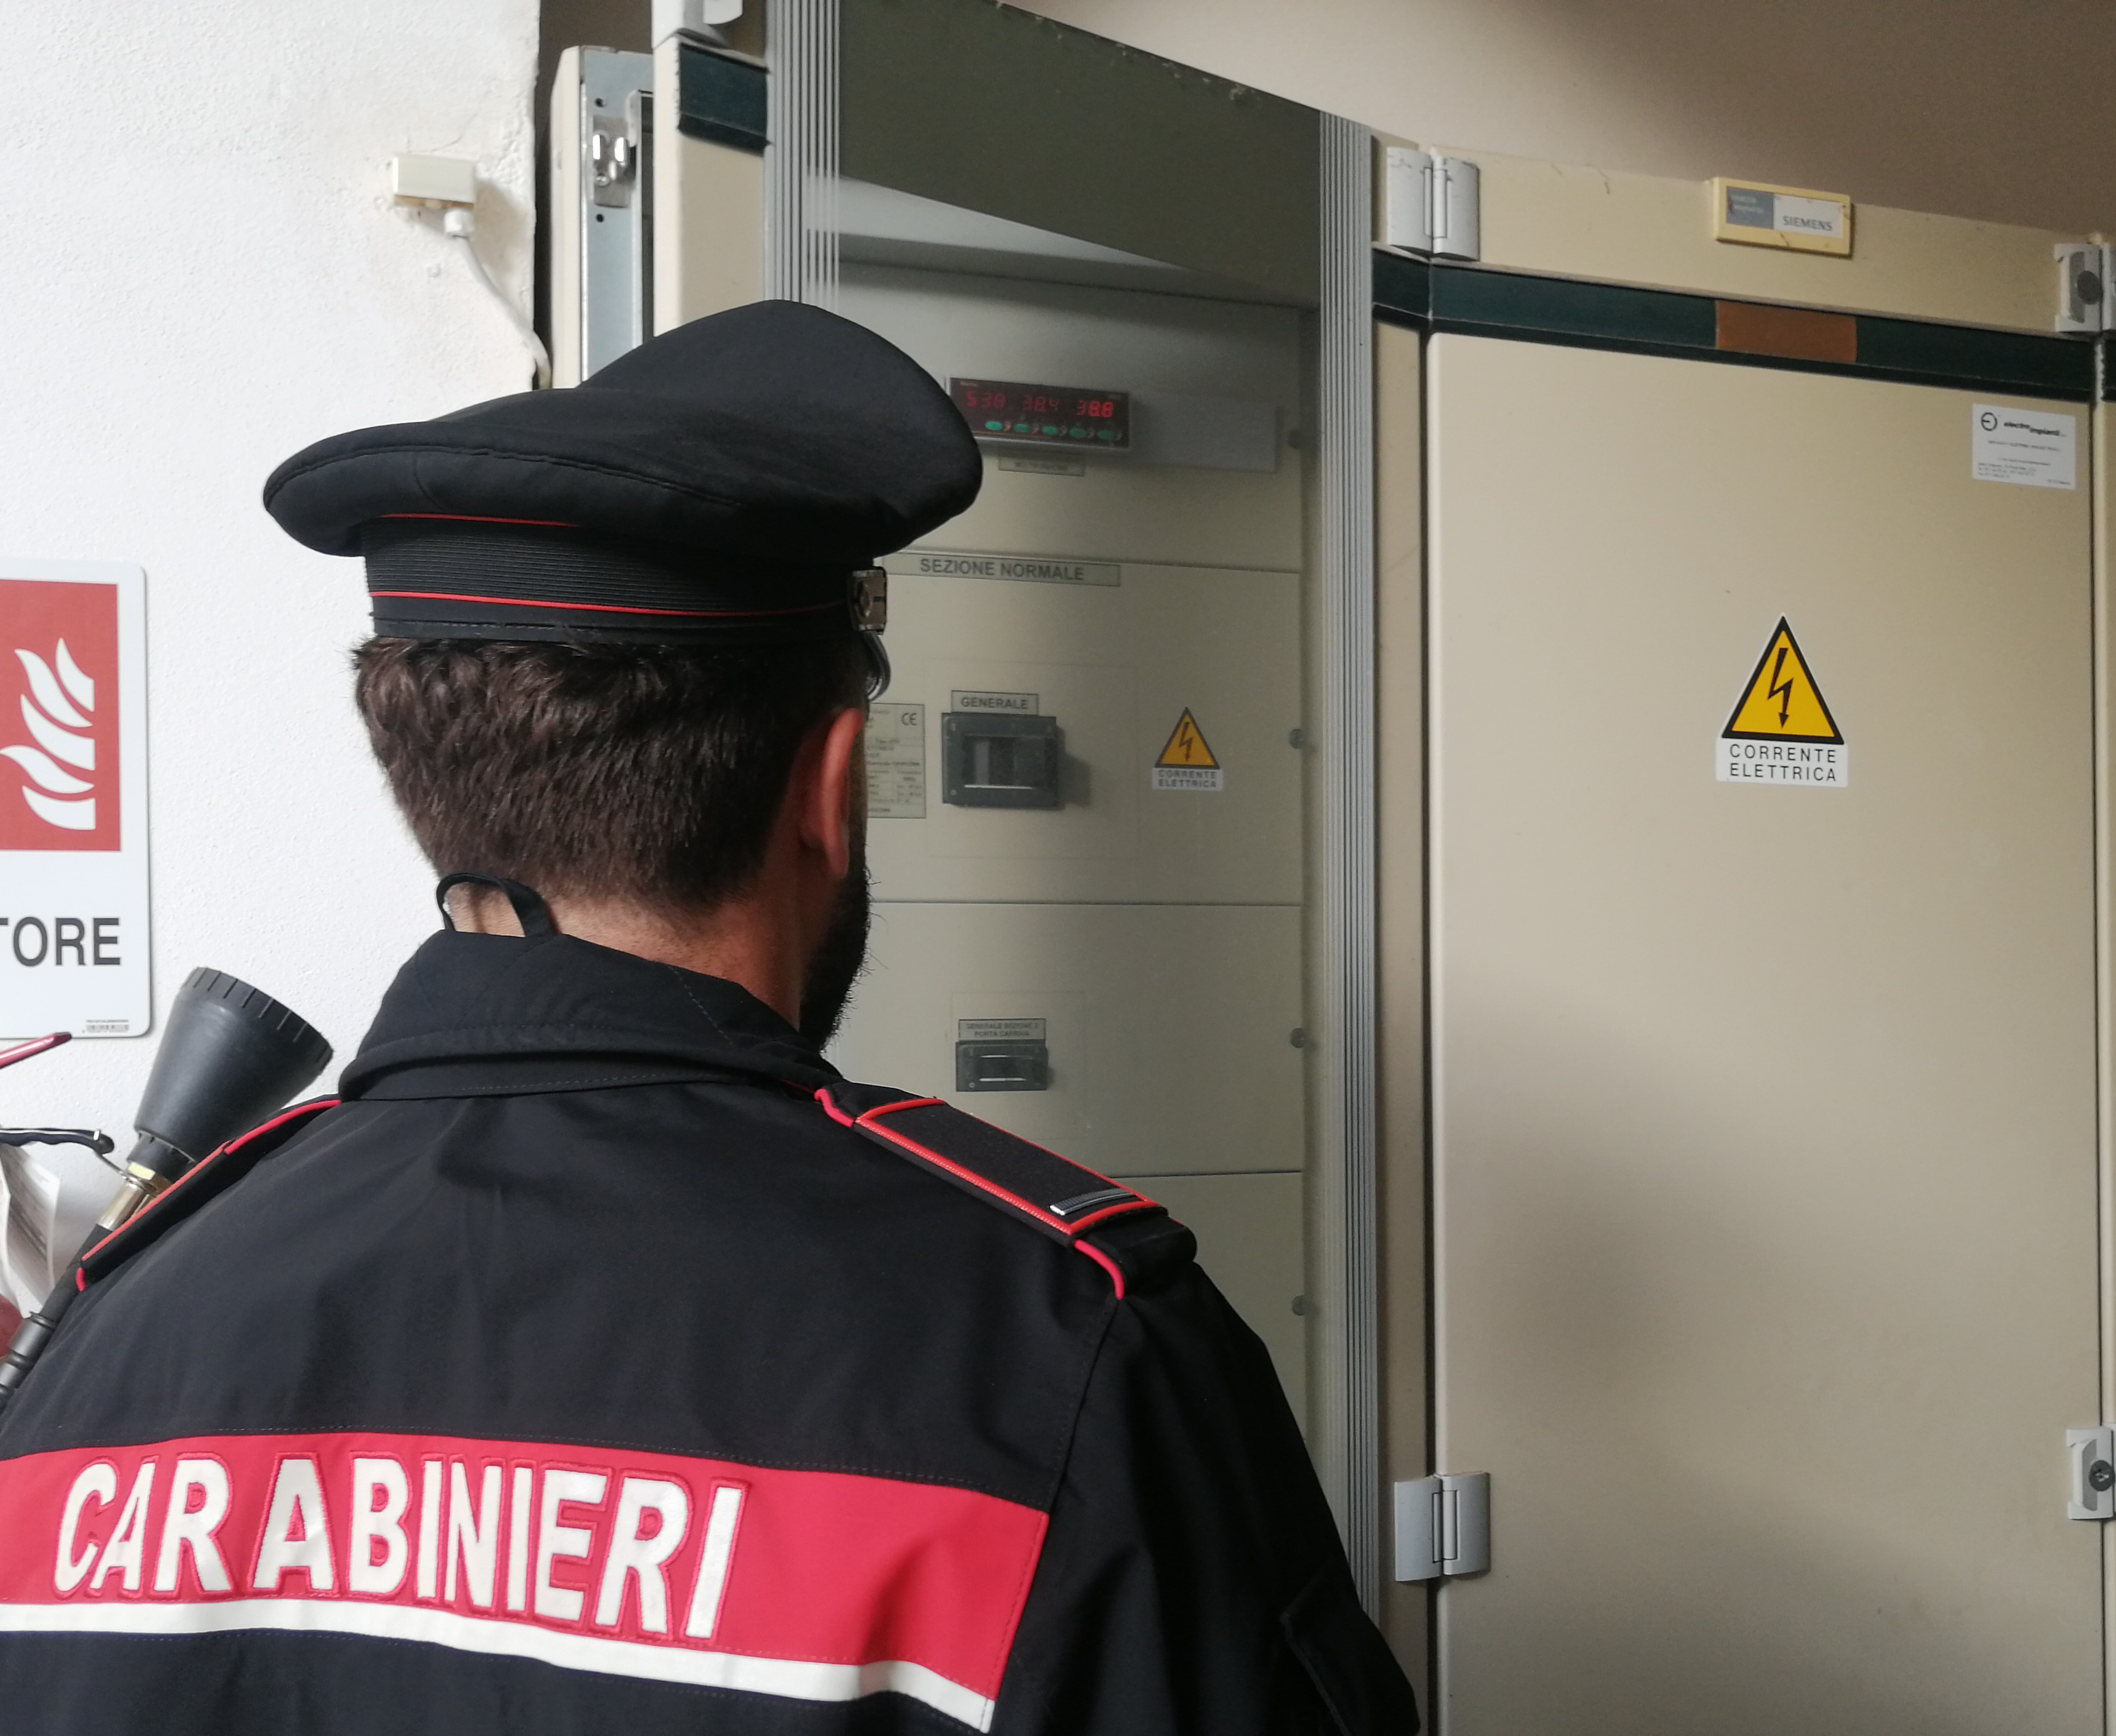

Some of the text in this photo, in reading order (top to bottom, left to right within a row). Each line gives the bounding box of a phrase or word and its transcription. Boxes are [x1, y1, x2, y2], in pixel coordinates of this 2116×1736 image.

[1782, 215, 1833, 231] SIEMENS
[920, 558, 1084, 581] SEZIONE NORMALE
[961, 696, 1029, 709] GENERALE
[901, 712, 917, 726] CE
[1729, 743, 1836, 763] CORRENTE
[1158, 769, 1217, 779] CORRENTE
[1730, 762, 1836, 782] ELETTRICA
[1158, 779, 1217, 788] ELETTRICA
[0, 916, 121, 967] ORE
[51, 1453, 748, 1640] CARABINIERI
